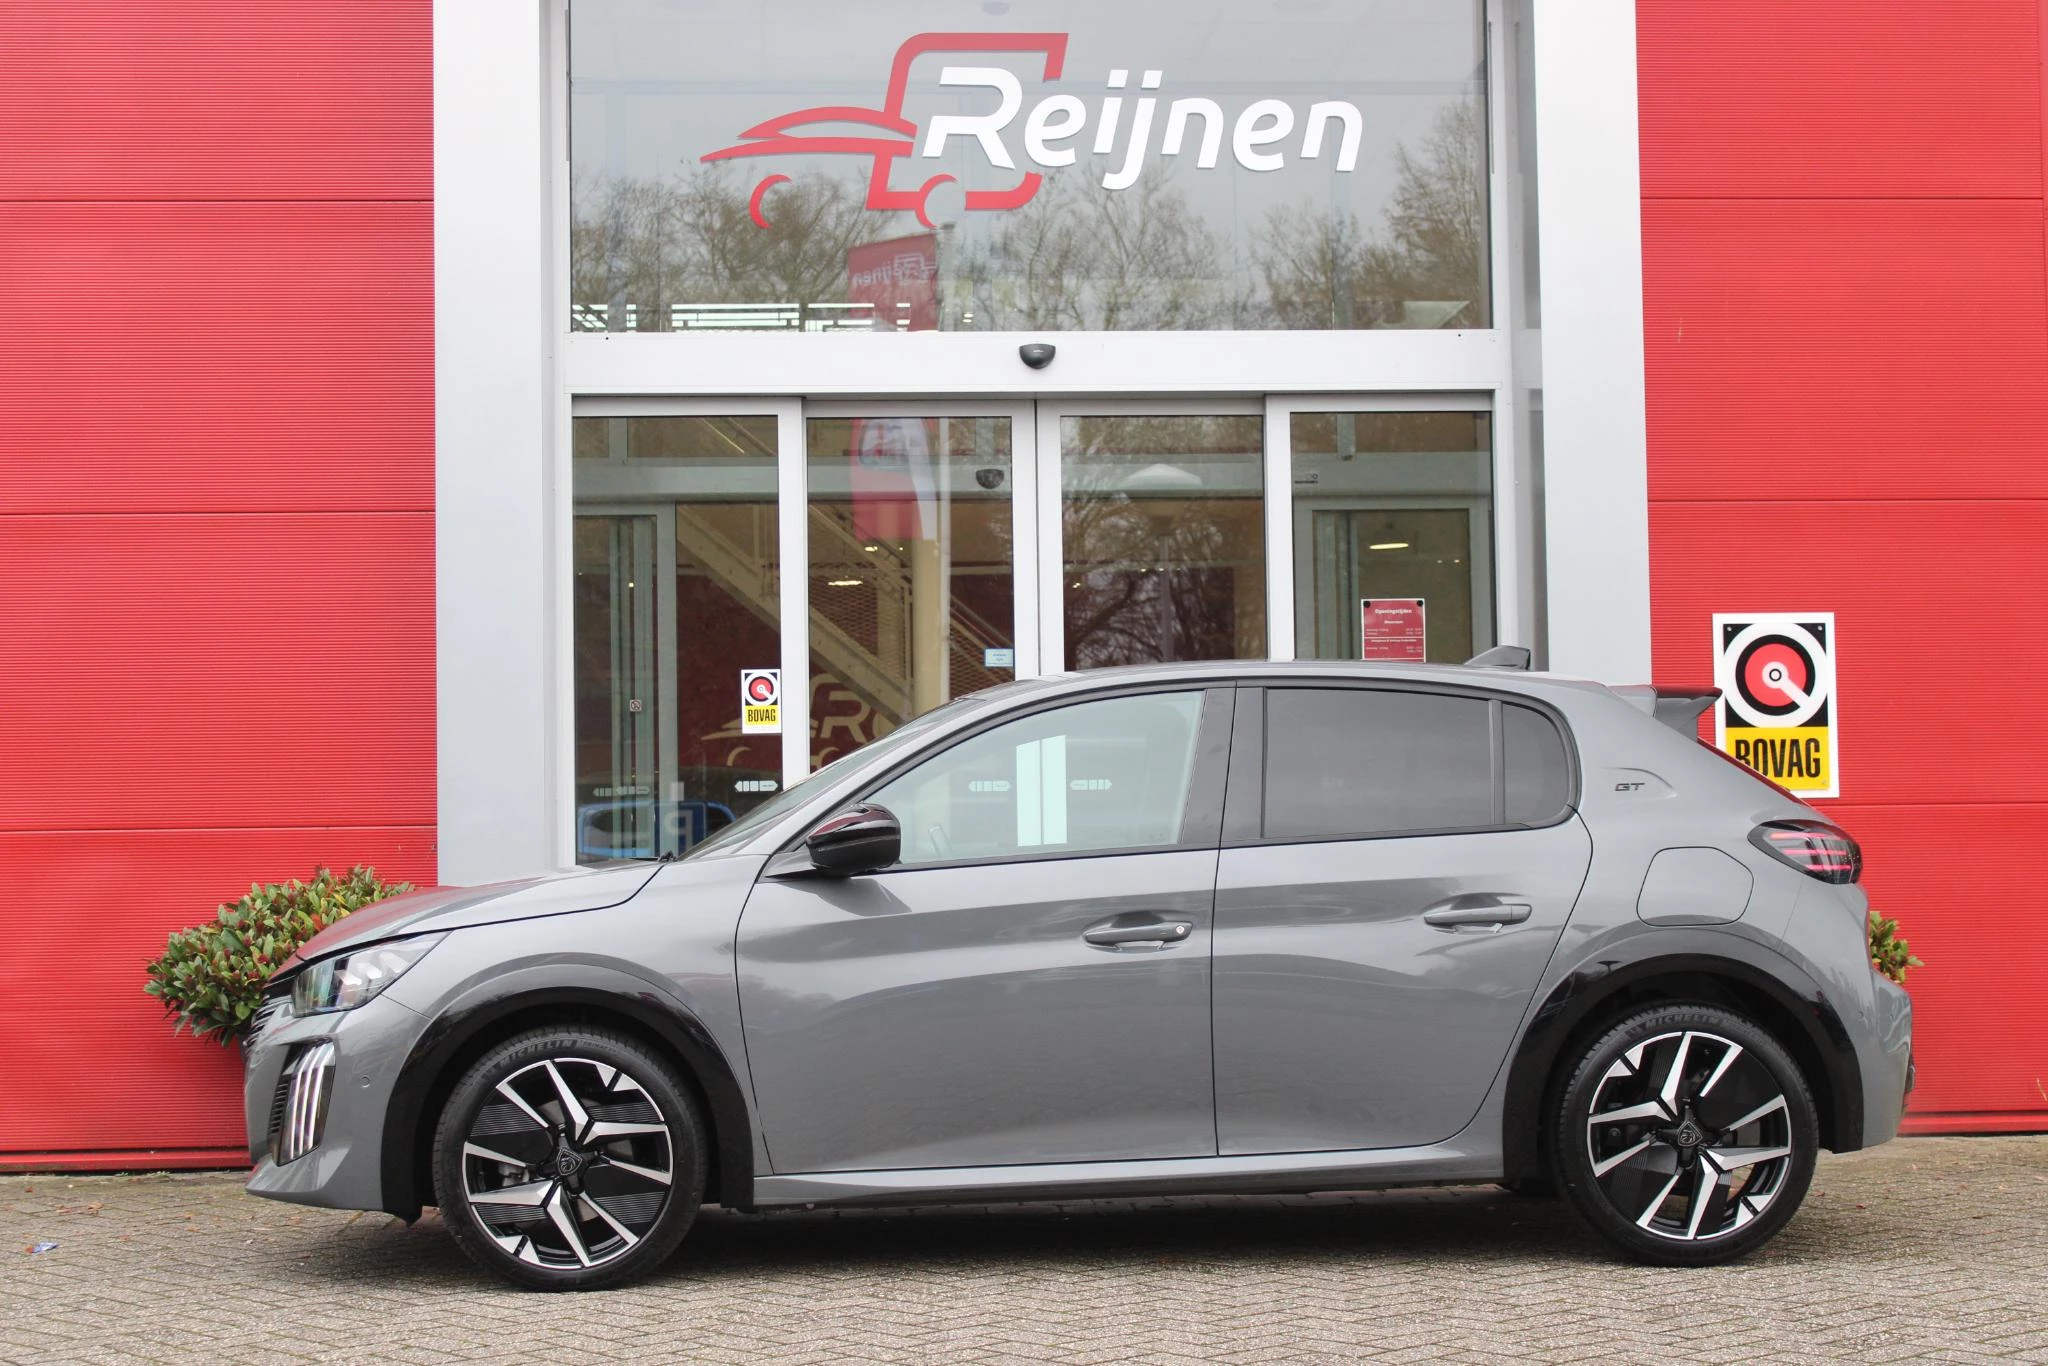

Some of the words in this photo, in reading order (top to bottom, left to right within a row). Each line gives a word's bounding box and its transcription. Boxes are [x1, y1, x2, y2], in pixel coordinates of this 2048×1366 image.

[922, 66, 1363, 190] Reijnen
[747, 708, 776, 722] BOVAG
[1735, 738, 1821, 778] BOVAG
[1615, 782, 1646, 792] GT
[1646, 1013, 1719, 1028] MICHELIN
[500, 1040, 572, 1065] MICHELIN
